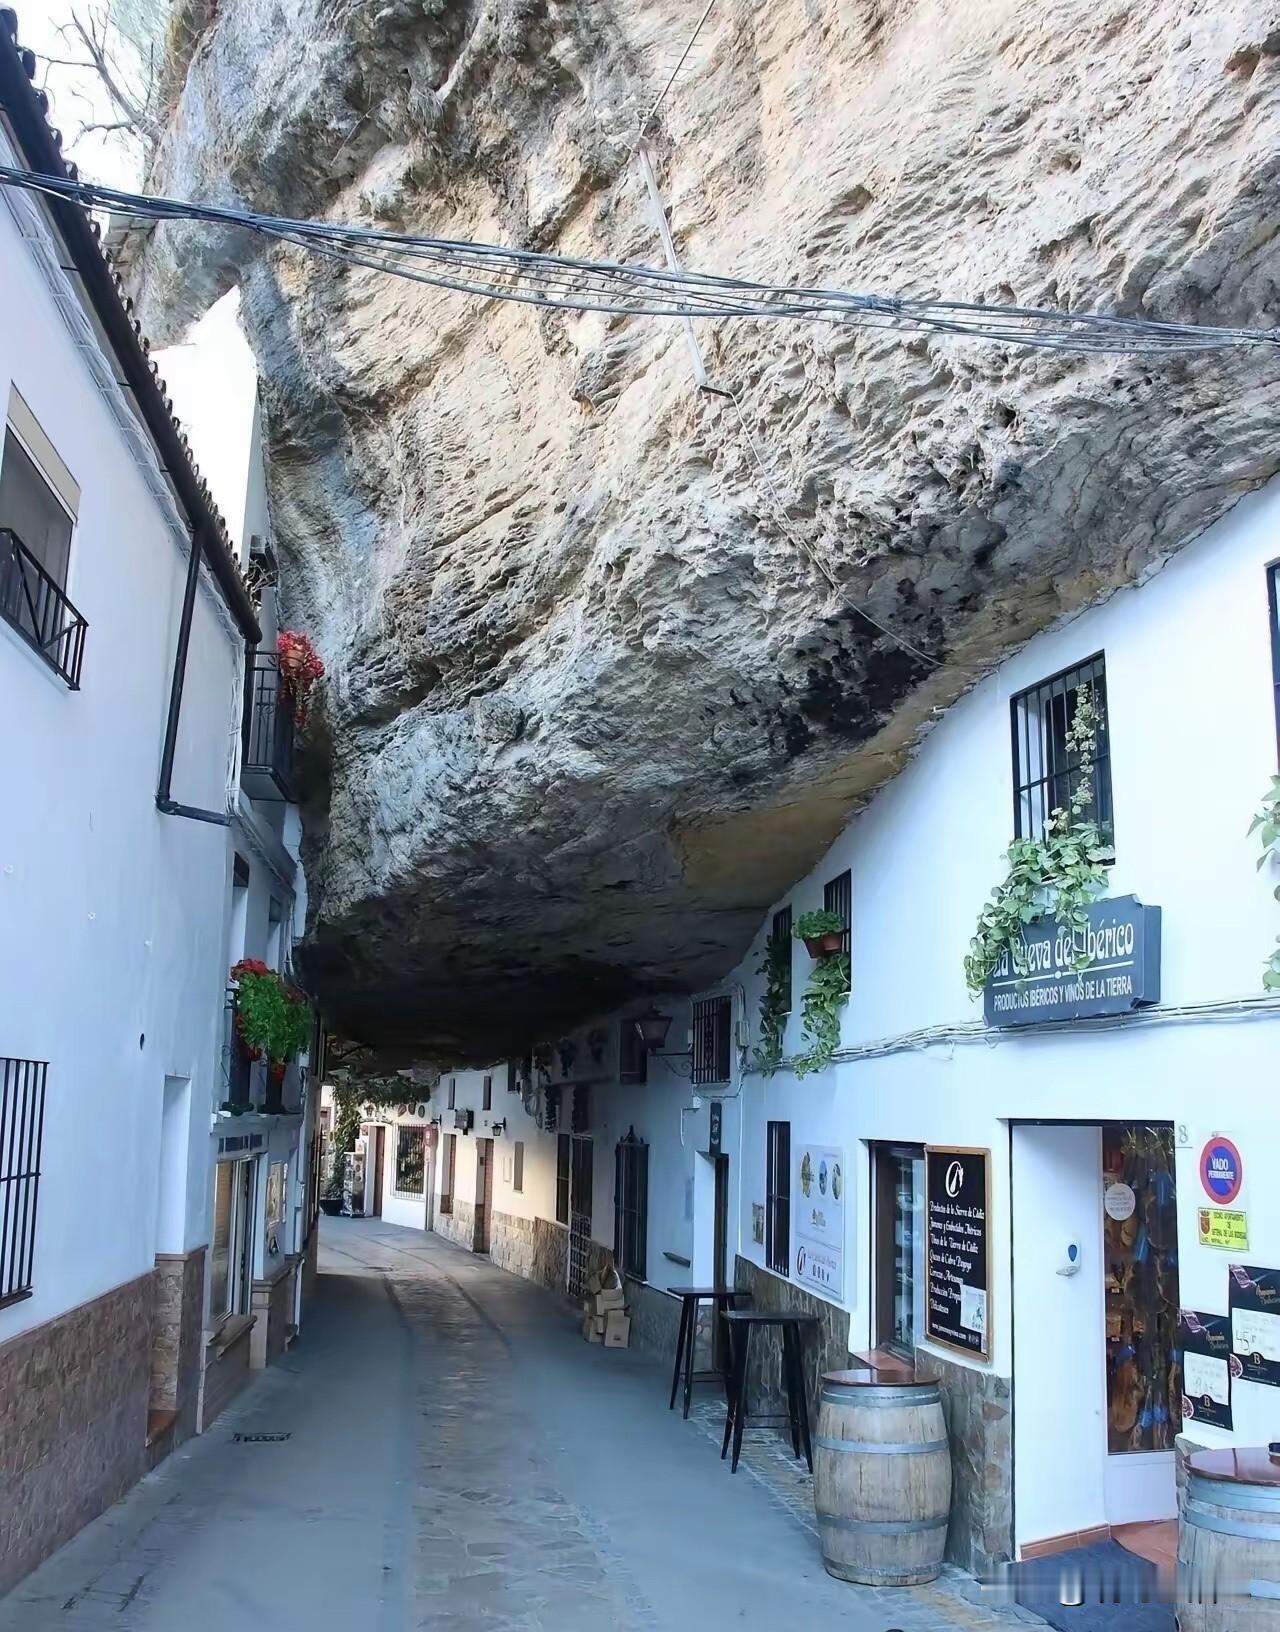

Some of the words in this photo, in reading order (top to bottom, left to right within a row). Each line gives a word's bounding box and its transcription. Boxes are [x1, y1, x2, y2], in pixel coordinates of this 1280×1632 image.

[1030, 984, 1059, 1007] IBÉRICOS
[1058, 985, 1064, 1003] Y
[1064, 982, 1084, 1003] VINOS
[1085, 980, 1095, 1000] DE
[1096, 979, 1106, 999] LA
[1106, 975, 1132, 997] TIERRA
[1178, 1124, 1188, 1144] 8
[1211, 1158, 1229, 1171] VADO
